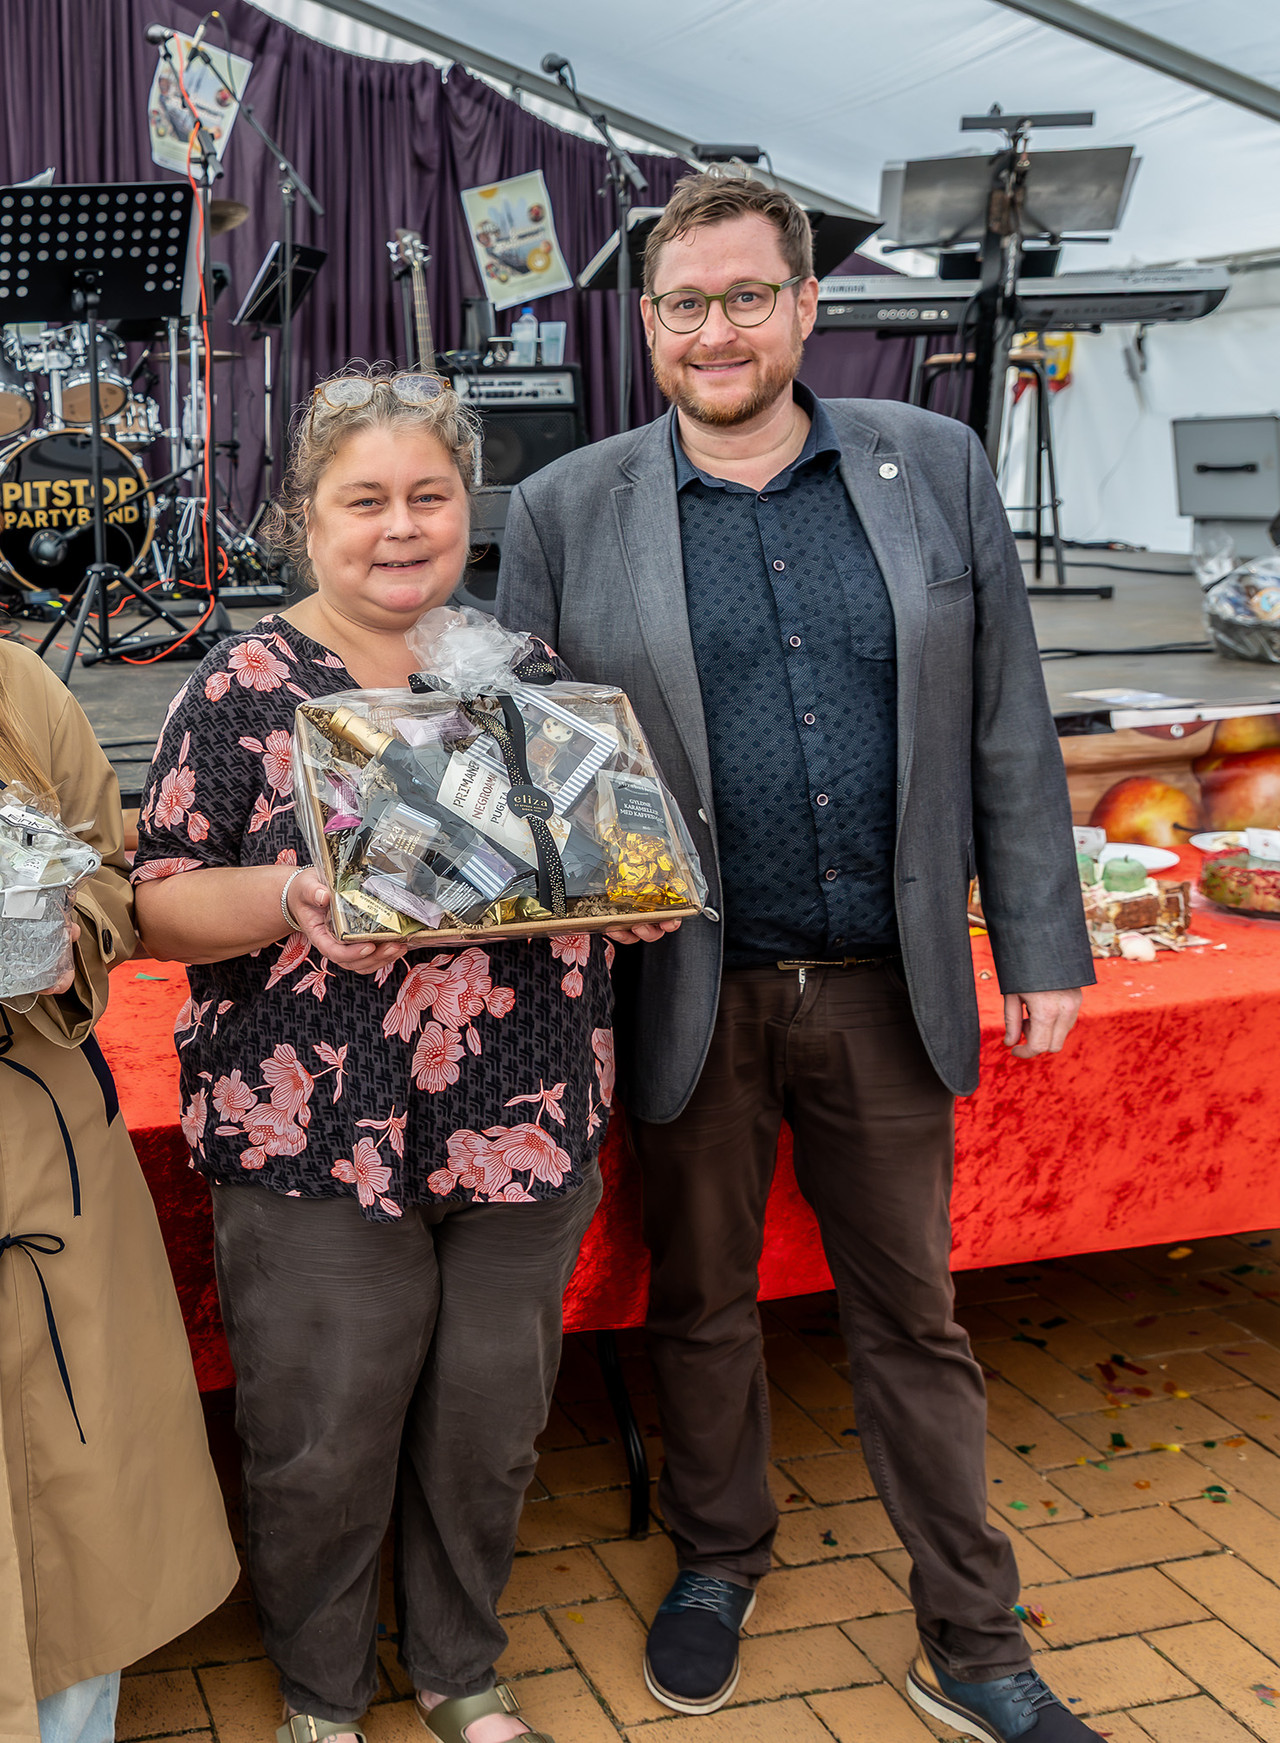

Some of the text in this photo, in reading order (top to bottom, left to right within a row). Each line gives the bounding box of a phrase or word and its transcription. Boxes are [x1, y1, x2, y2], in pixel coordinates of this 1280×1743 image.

[2, 477, 138, 510] PITSTOP
[3, 506, 139, 529] PARTYBND
[513, 794, 548, 807] eliza
